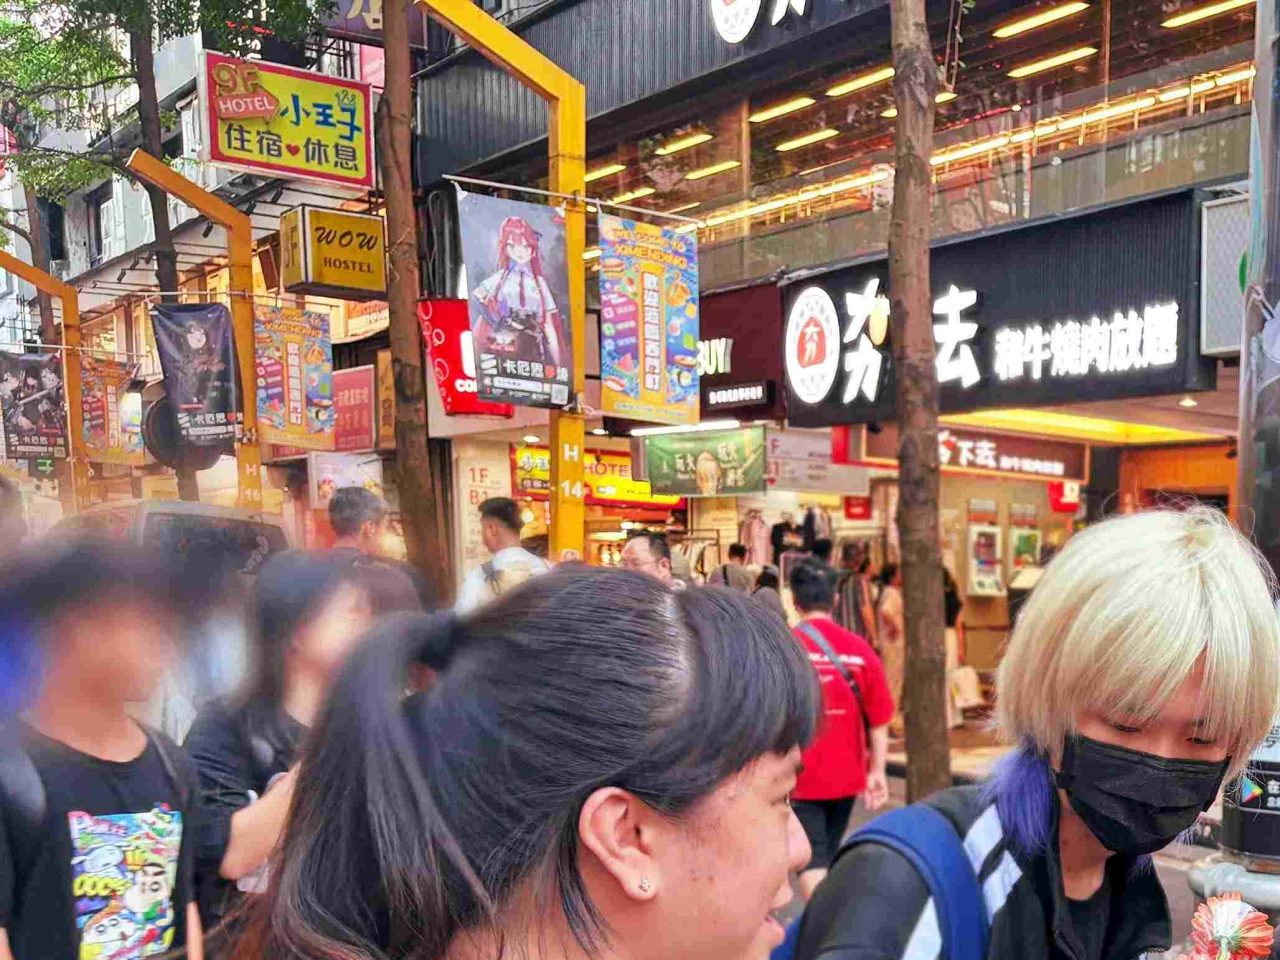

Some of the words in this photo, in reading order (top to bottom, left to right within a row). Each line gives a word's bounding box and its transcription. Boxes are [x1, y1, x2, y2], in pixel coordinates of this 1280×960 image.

[212, 64, 259, 94] 9F
[219, 96, 275, 114] HOTEL
[280, 93, 362, 142] 小王子
[225, 122, 282, 158] 住宿
[303, 137, 359, 171] 休息
[315, 226, 378, 251] WOW
[323, 256, 374, 273] HOSTEL
[843, 277, 981, 405] 夯去
[564, 443, 579, 461] H
[560, 480, 583, 498] 14
